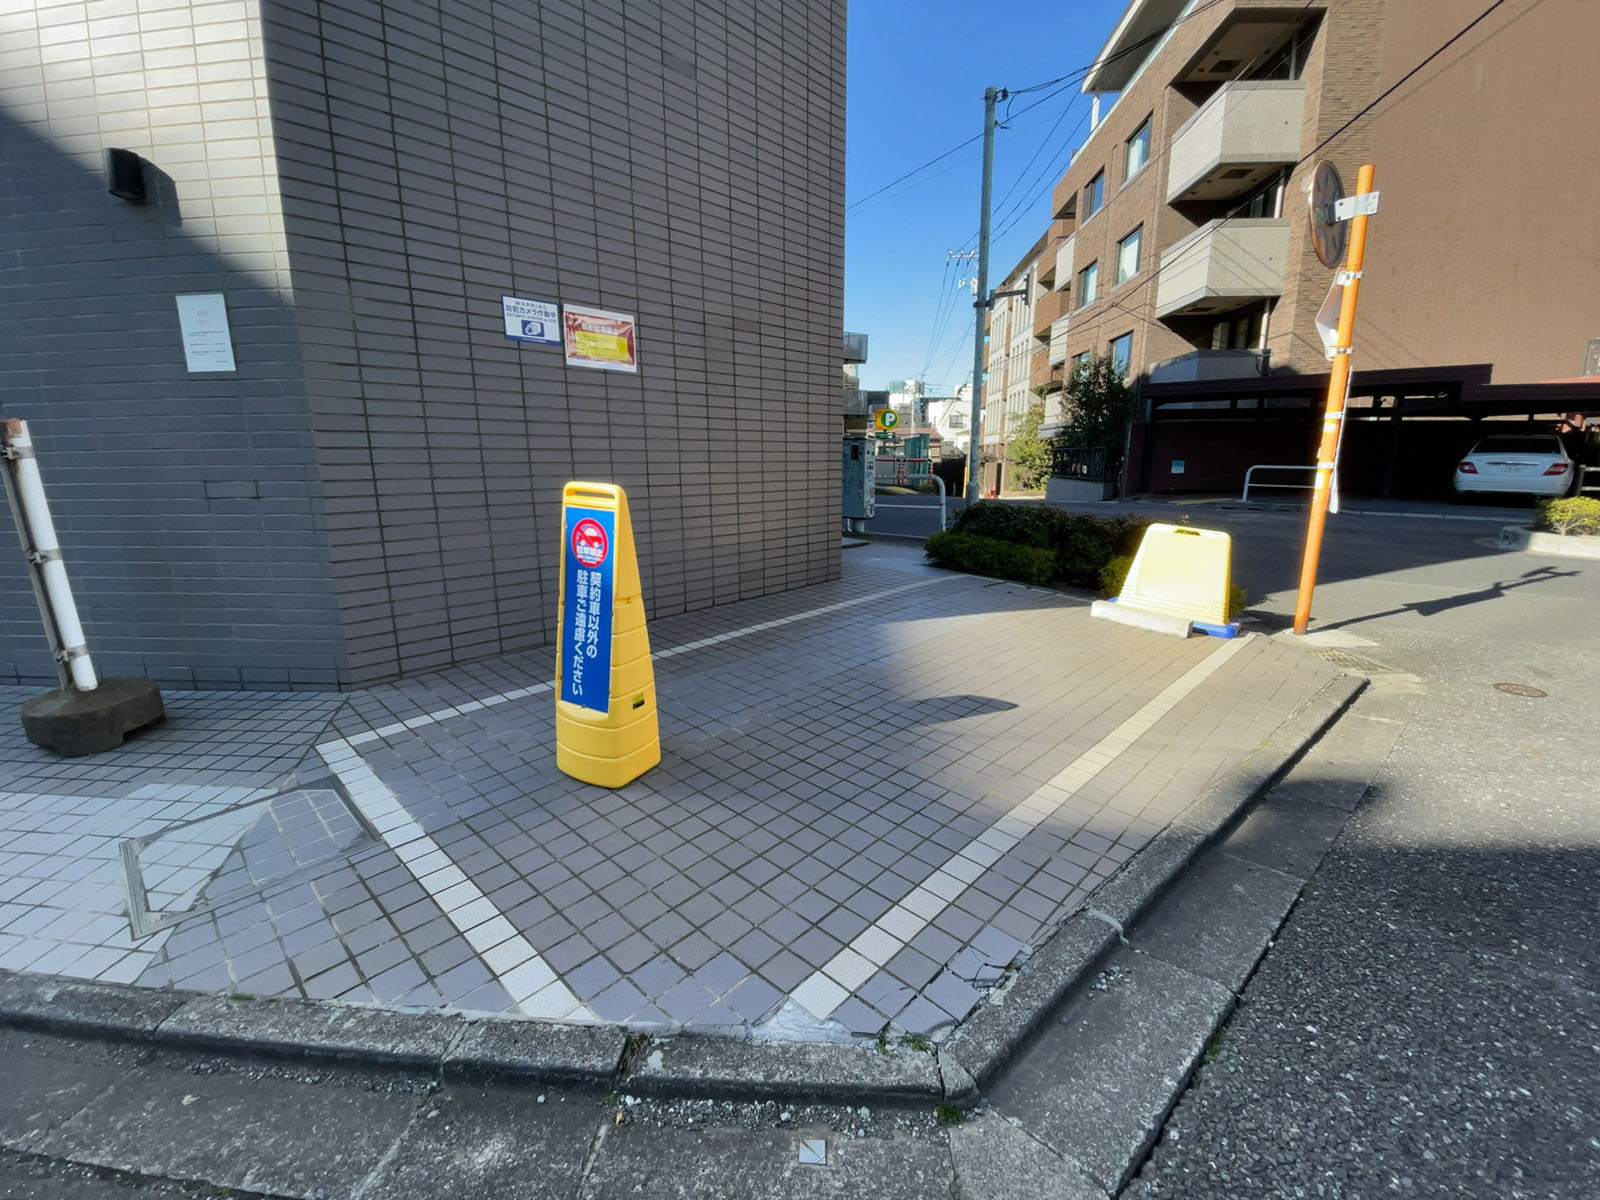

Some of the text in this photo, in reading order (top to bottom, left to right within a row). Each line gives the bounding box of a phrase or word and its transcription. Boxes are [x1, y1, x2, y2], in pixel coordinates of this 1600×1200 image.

[505, 304, 556, 318] 防犯カメラ作動中
[514, 301, 547, 310] WARNING
[885, 412, 896, 426] P
[586, 571, 602, 659] 契約車以外の
[572, 569, 589, 696] 駐車ご遠慮ください
